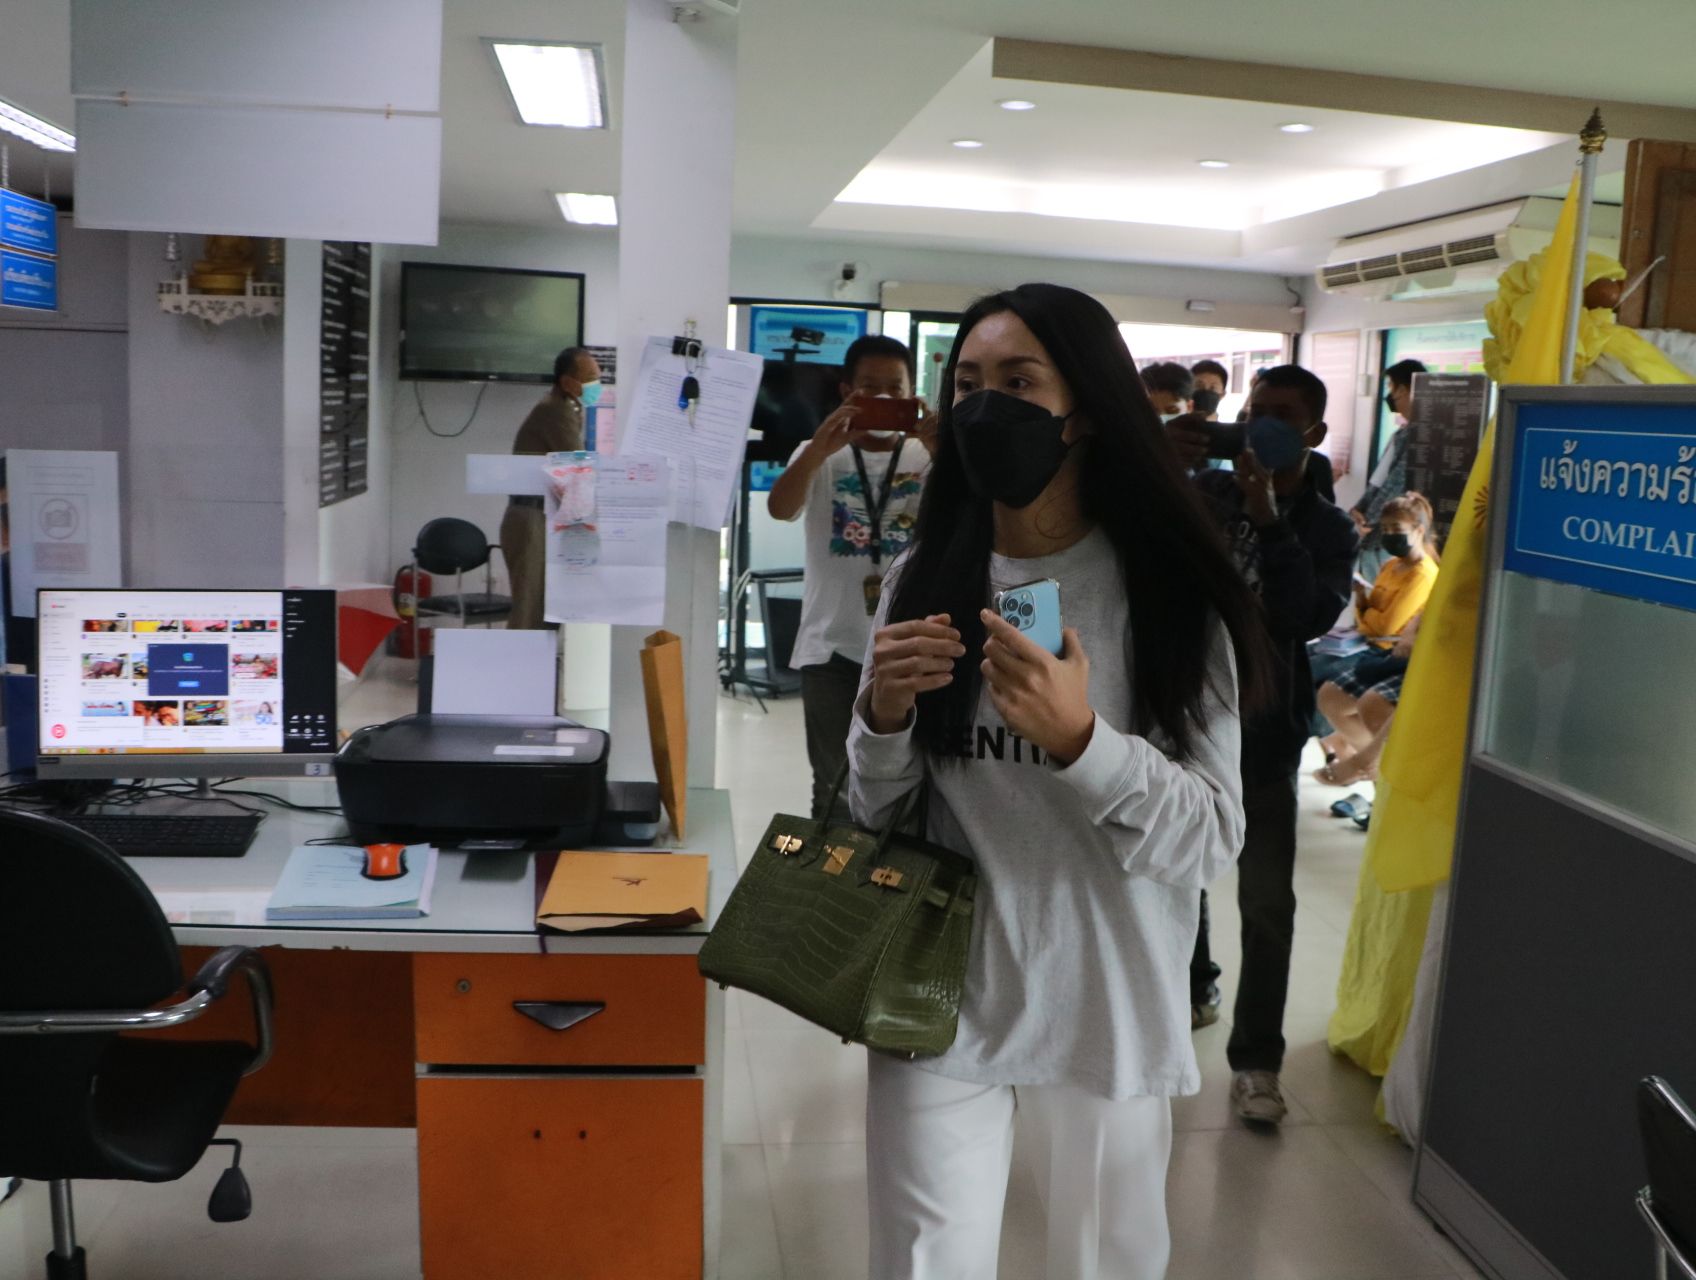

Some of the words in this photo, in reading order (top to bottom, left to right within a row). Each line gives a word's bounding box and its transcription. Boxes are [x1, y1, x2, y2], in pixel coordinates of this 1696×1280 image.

[1540, 439, 1696, 504] แจ้งความร้
[1562, 515, 1696, 559] COMPLAI
